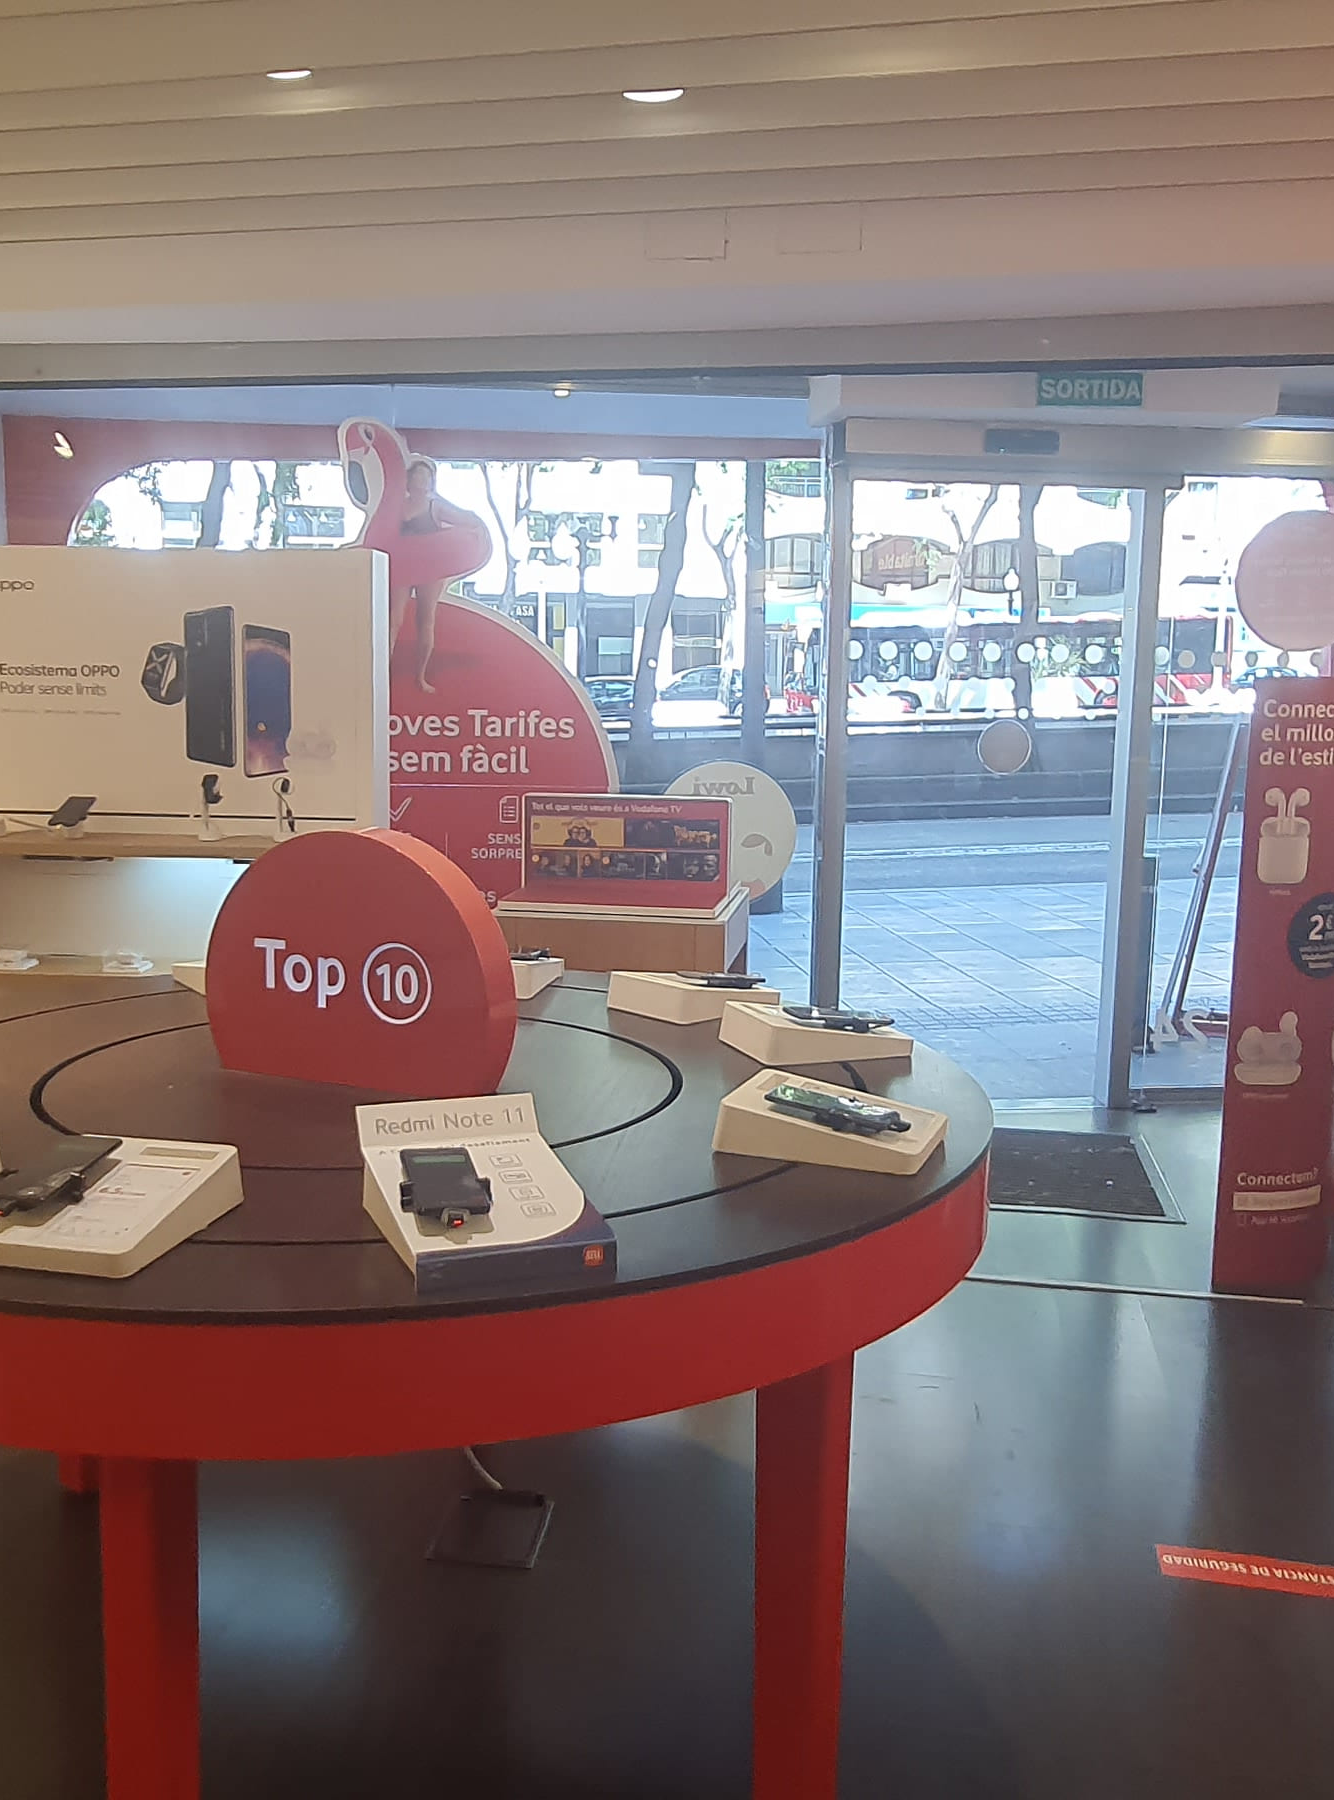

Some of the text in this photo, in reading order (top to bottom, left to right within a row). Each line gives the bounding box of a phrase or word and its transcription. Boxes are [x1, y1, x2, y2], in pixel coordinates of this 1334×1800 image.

[1040, 378, 1140, 400] SORTIDA
[0, 663, 120, 677] Ecosistema OPPO
[0, 681, 35, 694] Poder
[38, 684, 73, 695] sense
[467, 709, 575, 738] Tarifes
[1261, 723, 1281, 741] el
[460, 743, 530, 773] fàcil
[1259, 747, 1285, 766] de
[531, 802, 544, 811] Tot
[670, 805, 682, 813] TV
[254, 938, 419, 1008] Top 10
[375, 1106, 524, 1135] Redmi Note 11
[1162, 1554, 1247, 1575] SEGURIDAD
[1250, 1565, 1270, 1577] DE
